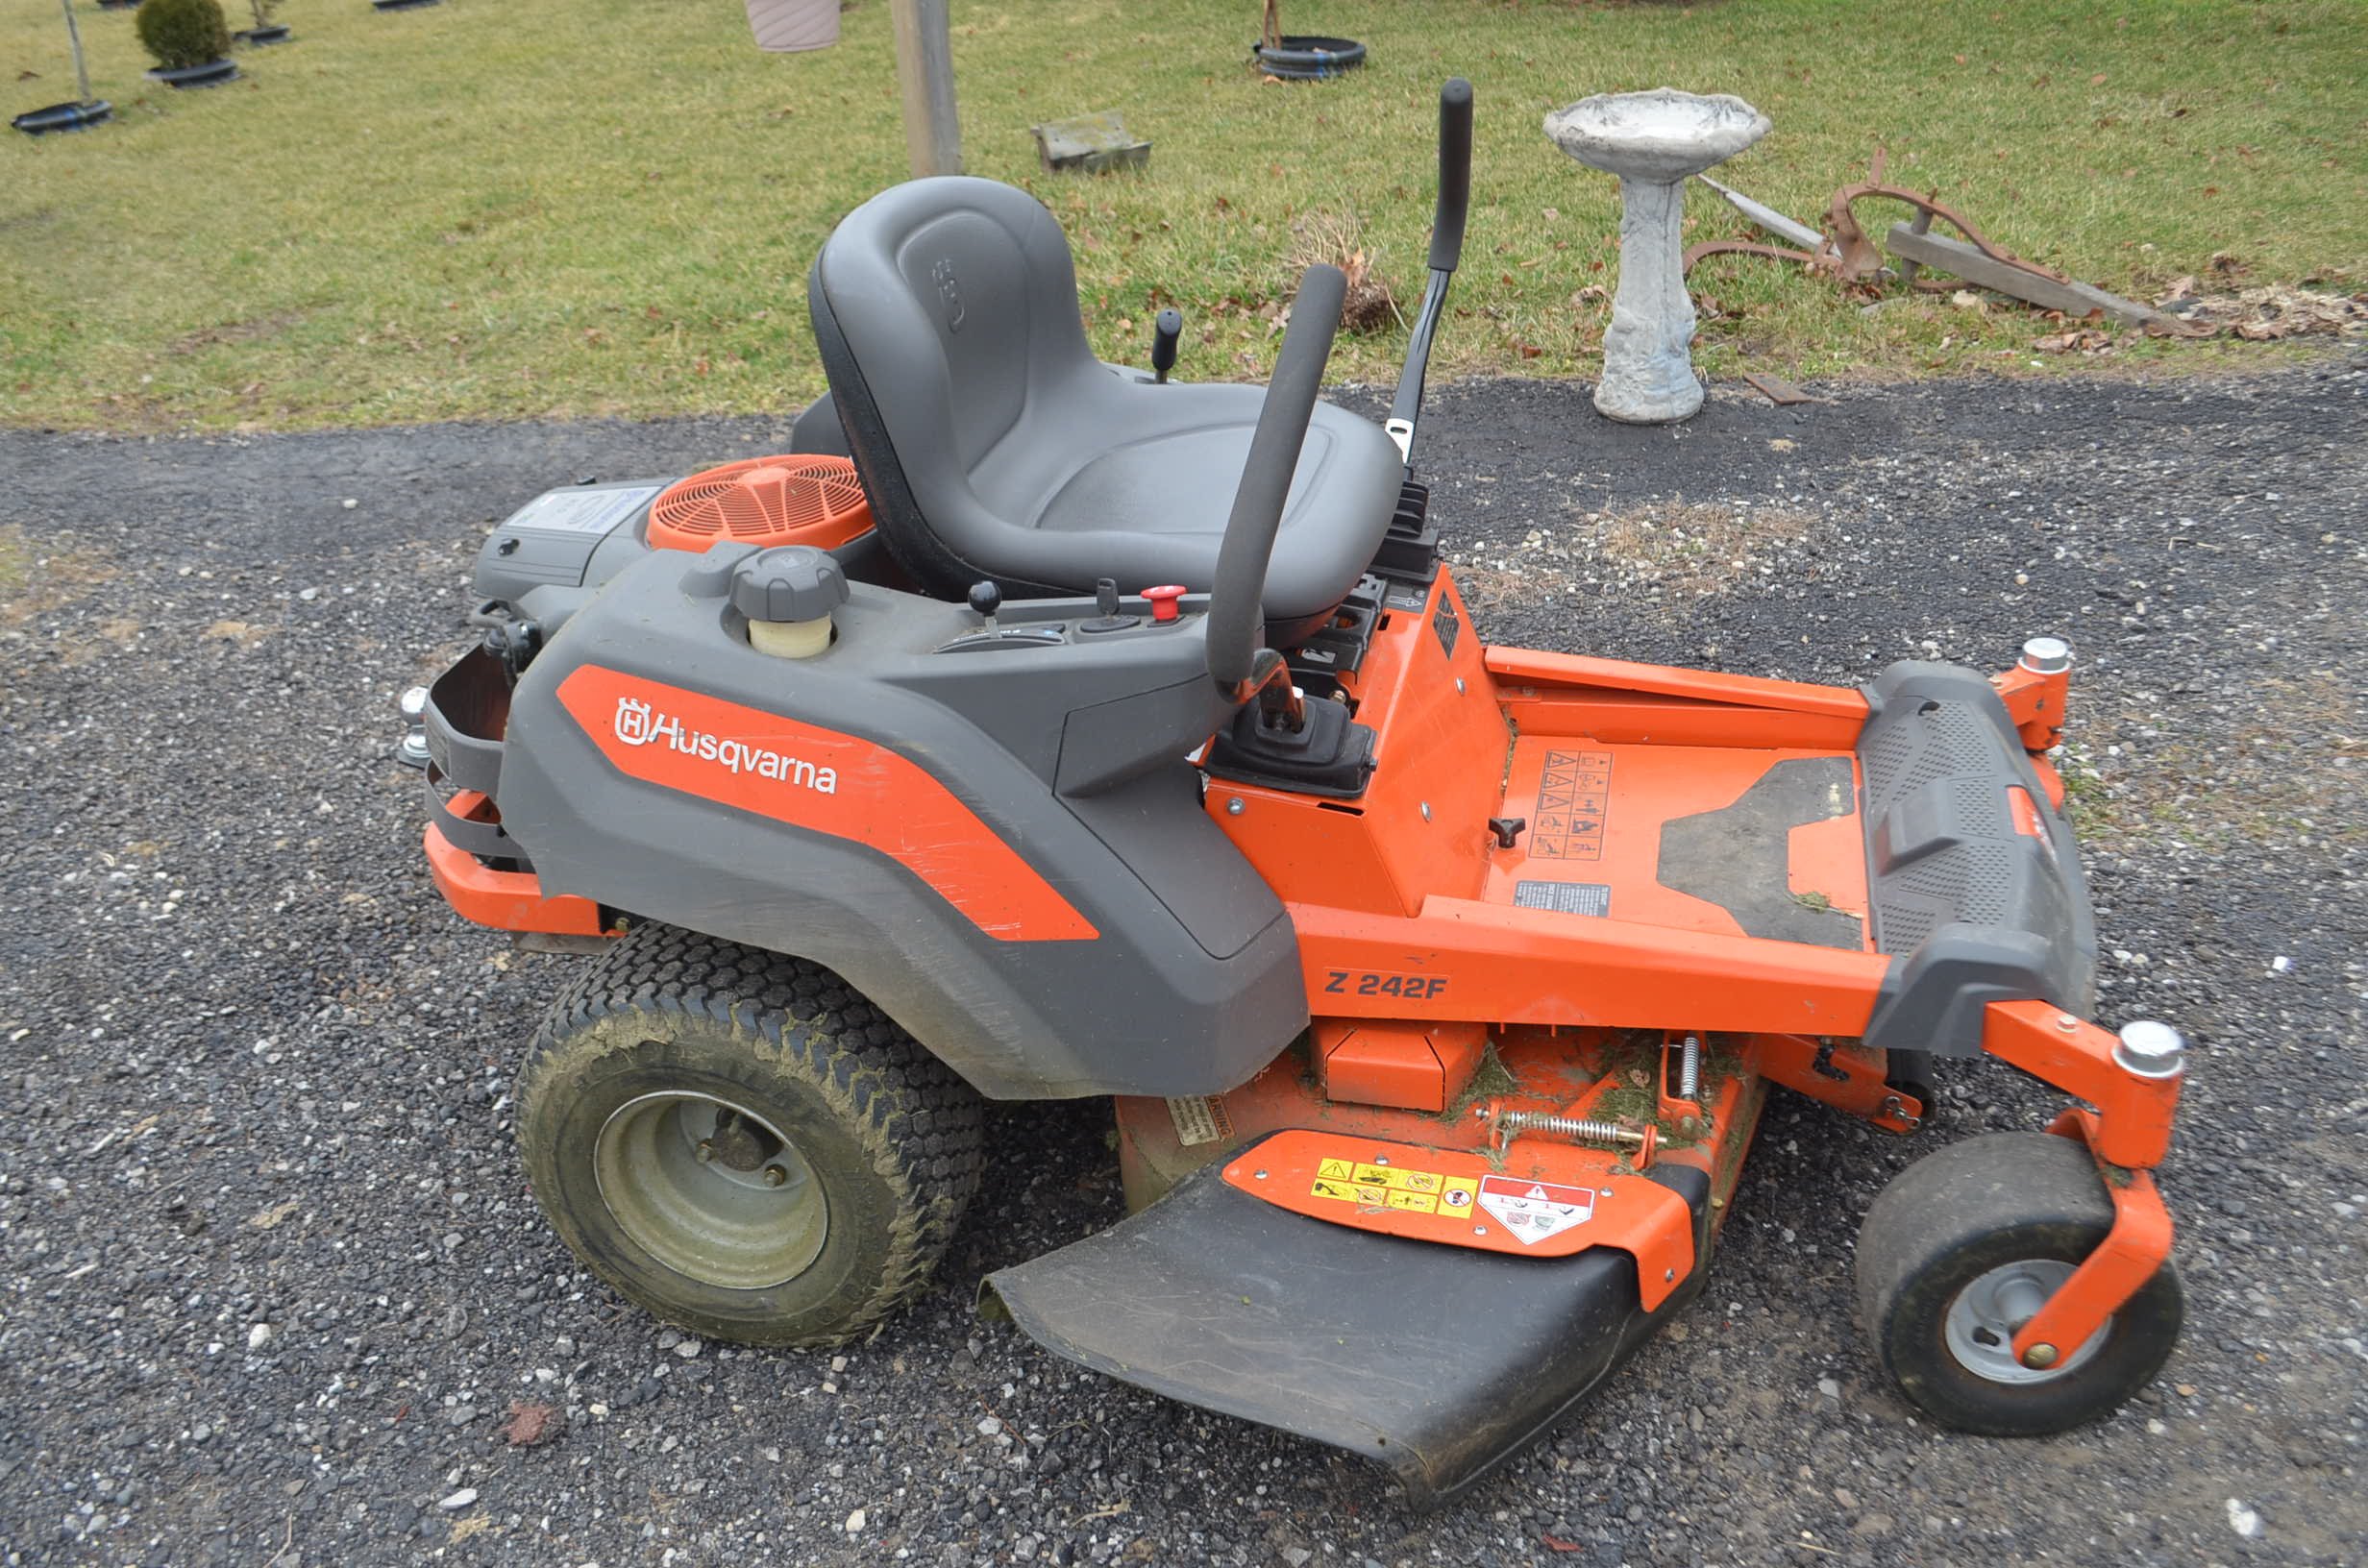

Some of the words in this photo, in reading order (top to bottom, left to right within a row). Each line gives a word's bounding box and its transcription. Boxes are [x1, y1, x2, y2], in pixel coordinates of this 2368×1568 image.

[647, 713, 838, 795] Husqvarna
[1324, 971, 1349, 993] Z
[1357, 973, 1447, 999] 242F
[1208, 1095, 1233, 1137] ARNING
